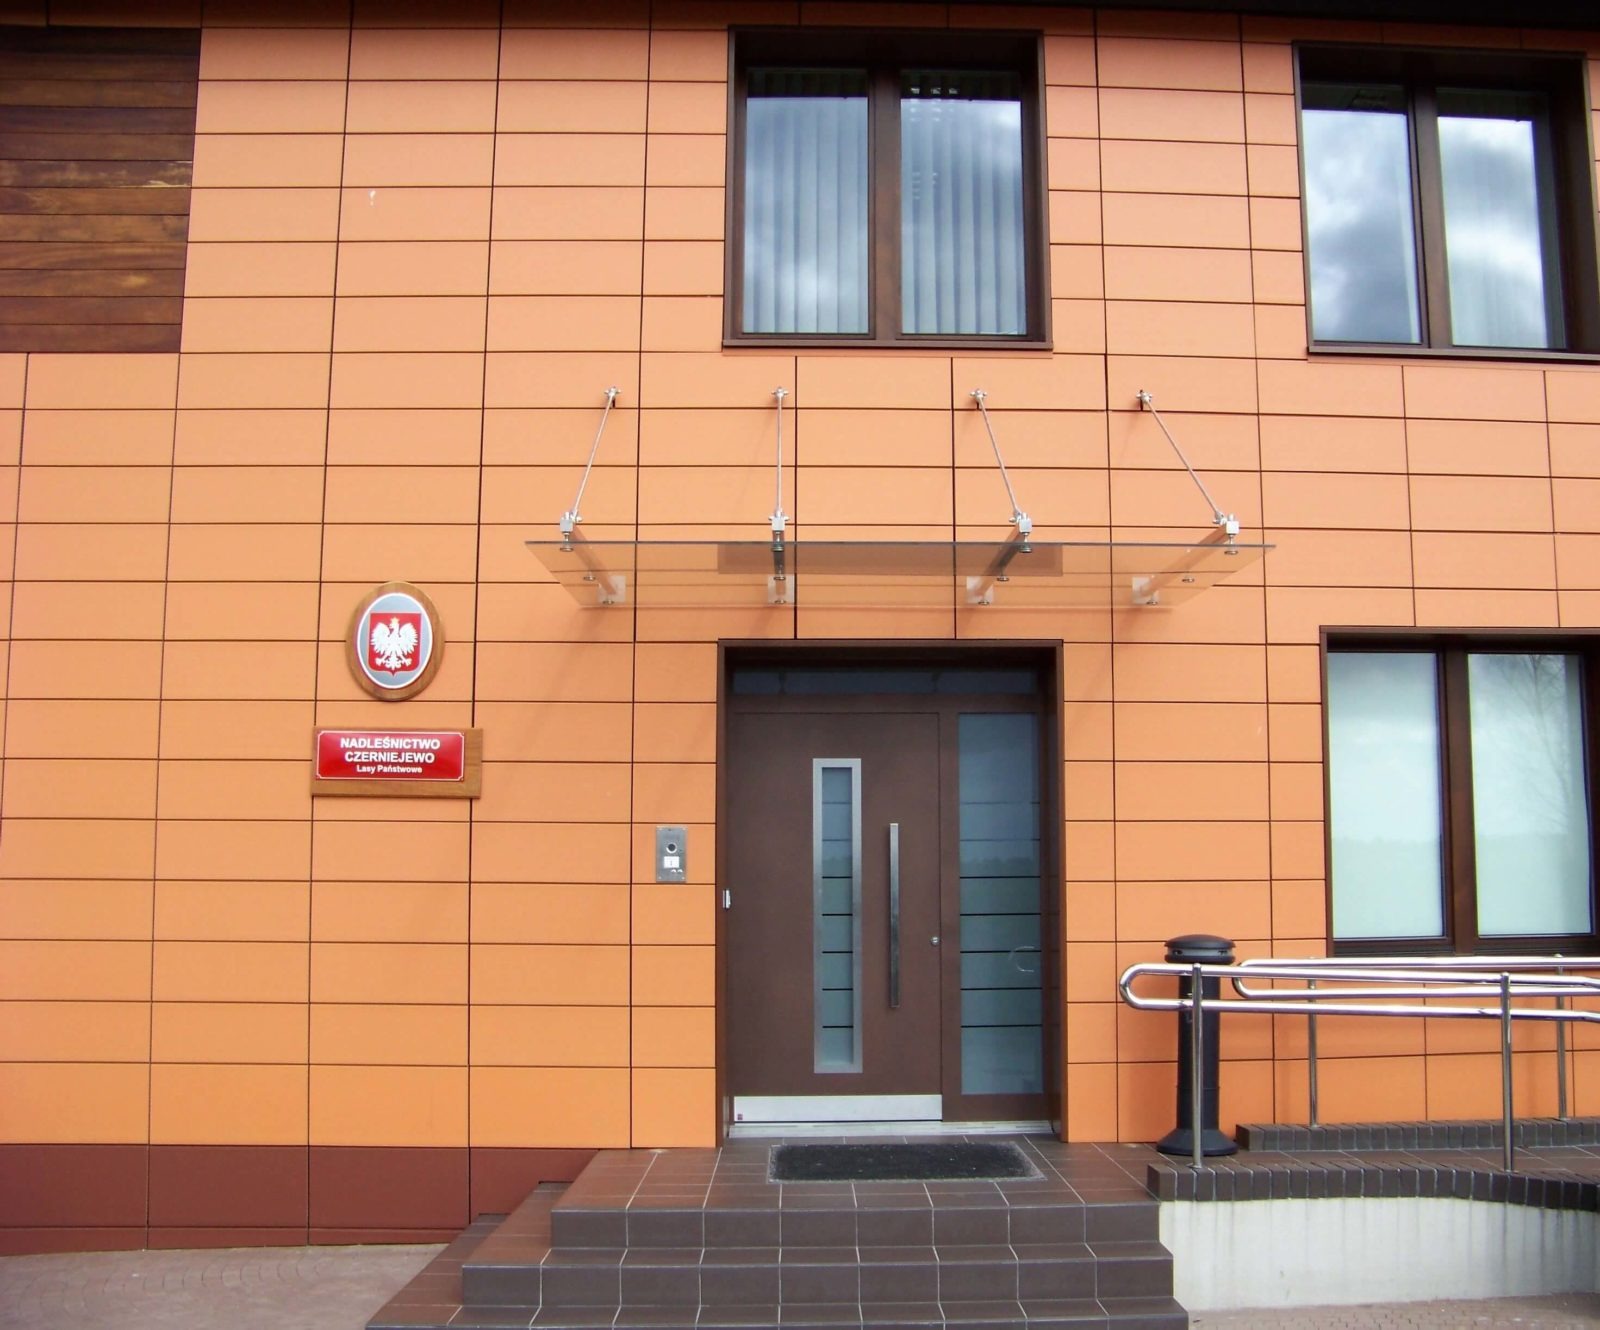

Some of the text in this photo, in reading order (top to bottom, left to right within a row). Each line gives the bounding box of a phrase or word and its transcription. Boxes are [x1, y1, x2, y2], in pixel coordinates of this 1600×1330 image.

[340, 736, 440, 749] NADLEŚNICTWO
[344, 751, 435, 763] CZERNIEJEWO
[356, 764, 422, 774] Lasy Państwowe
